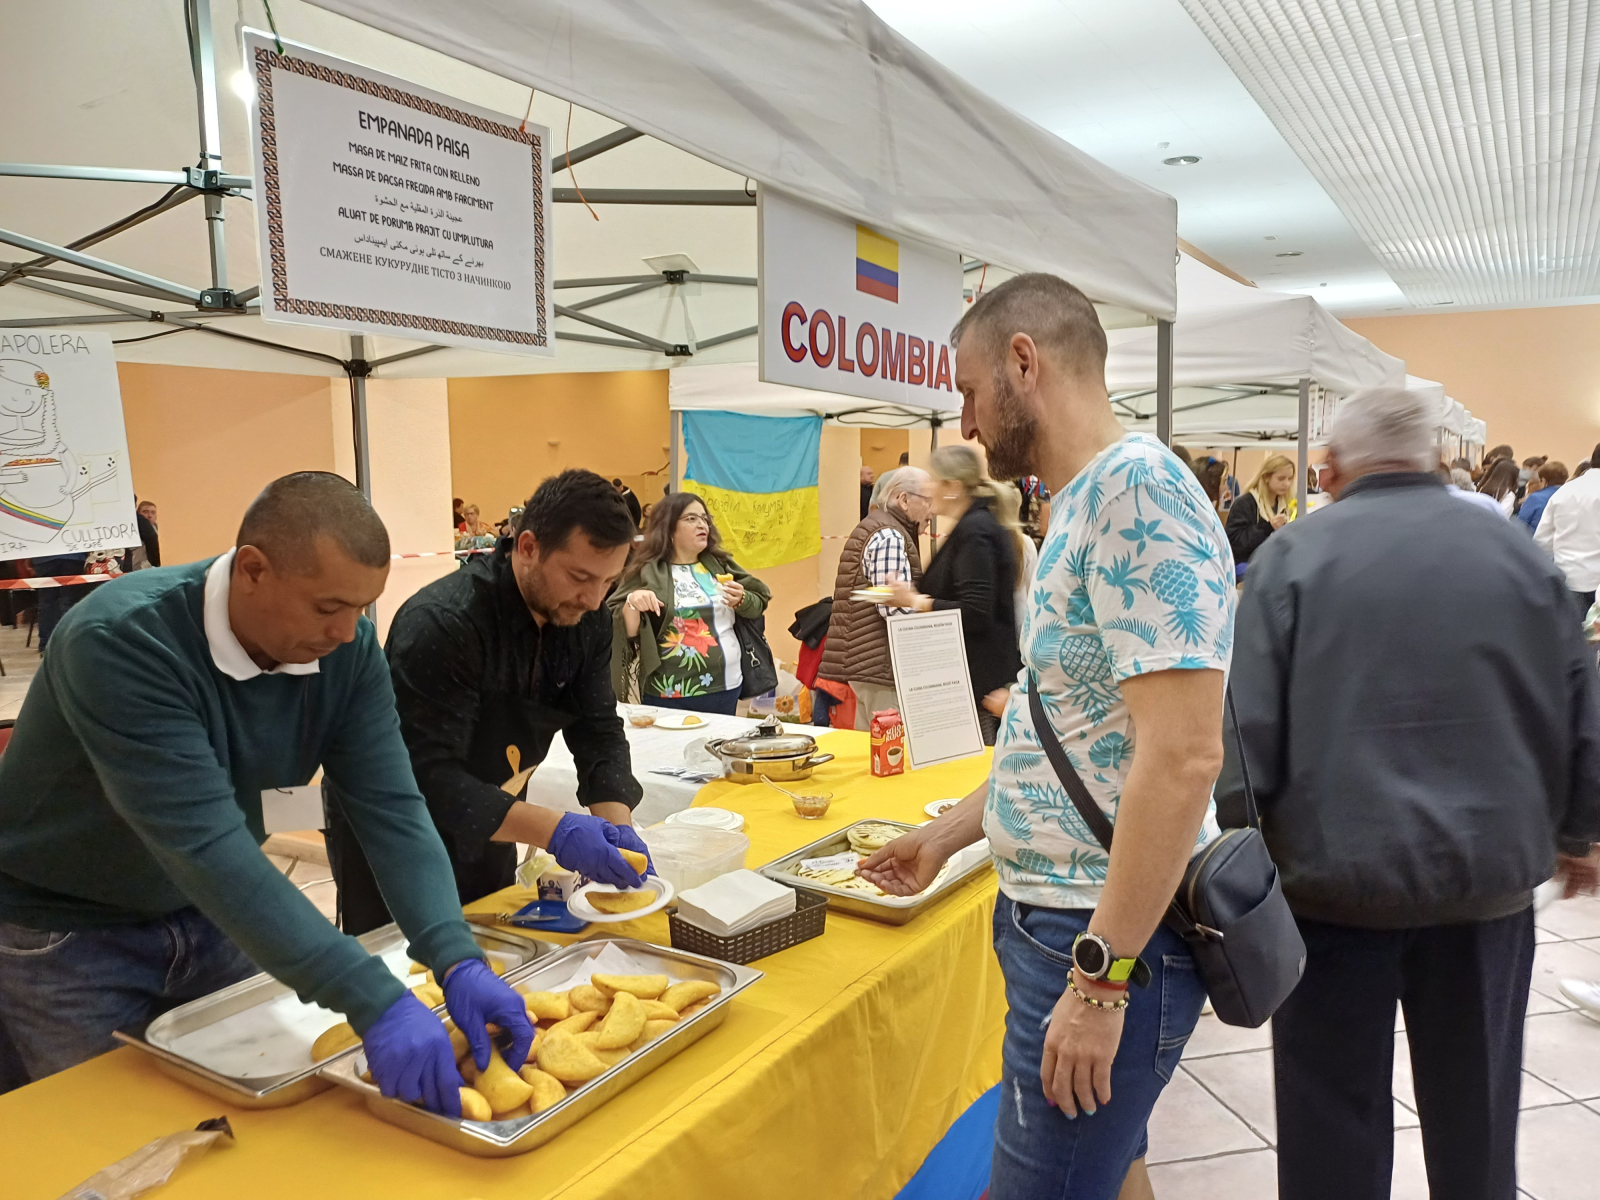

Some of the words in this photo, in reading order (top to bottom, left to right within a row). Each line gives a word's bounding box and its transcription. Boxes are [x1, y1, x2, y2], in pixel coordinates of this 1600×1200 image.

[358, 110, 433, 148] EMPANADA
[436, 134, 470, 160] PAISA
[332, 161, 364, 179] MASSA
[366, 169, 376, 182] DE
[378, 172, 404, 188] DACSA
[406, 179, 435, 196] FREGIDA
[436, 188, 452, 201] AMB
[454, 192, 494, 211] FARCIMENT
[348, 142, 374, 158] MASA
[376, 149, 386, 161] DE
[388, 152, 408, 167] MAIZ
[410, 158, 432, 174] FRITA
[433, 165, 448, 178] CON
[450, 169, 480, 187] RELLENO
[338, 206, 367, 222] ALUAT
[370, 212, 380, 225] DE
[382, 215, 413, 231] PORUMB
[416, 223, 440, 238] PRAJIT
[442, 230, 451, 240] CU
[453, 232, 494, 250] UMPLUTURA
[400, 203, 408, 212] مع
[320, 246, 372, 265] СМАЖЕНЕ
[375, 256, 430, 275] КУКУРУДНЕ
[431, 266, 455, 280] ТІСТО
[464, 273, 511, 291] НАЧИНКОЮ
[781, 301, 953, 393] COLOMBIA
[61, 522, 138, 545] CULLIDORA
